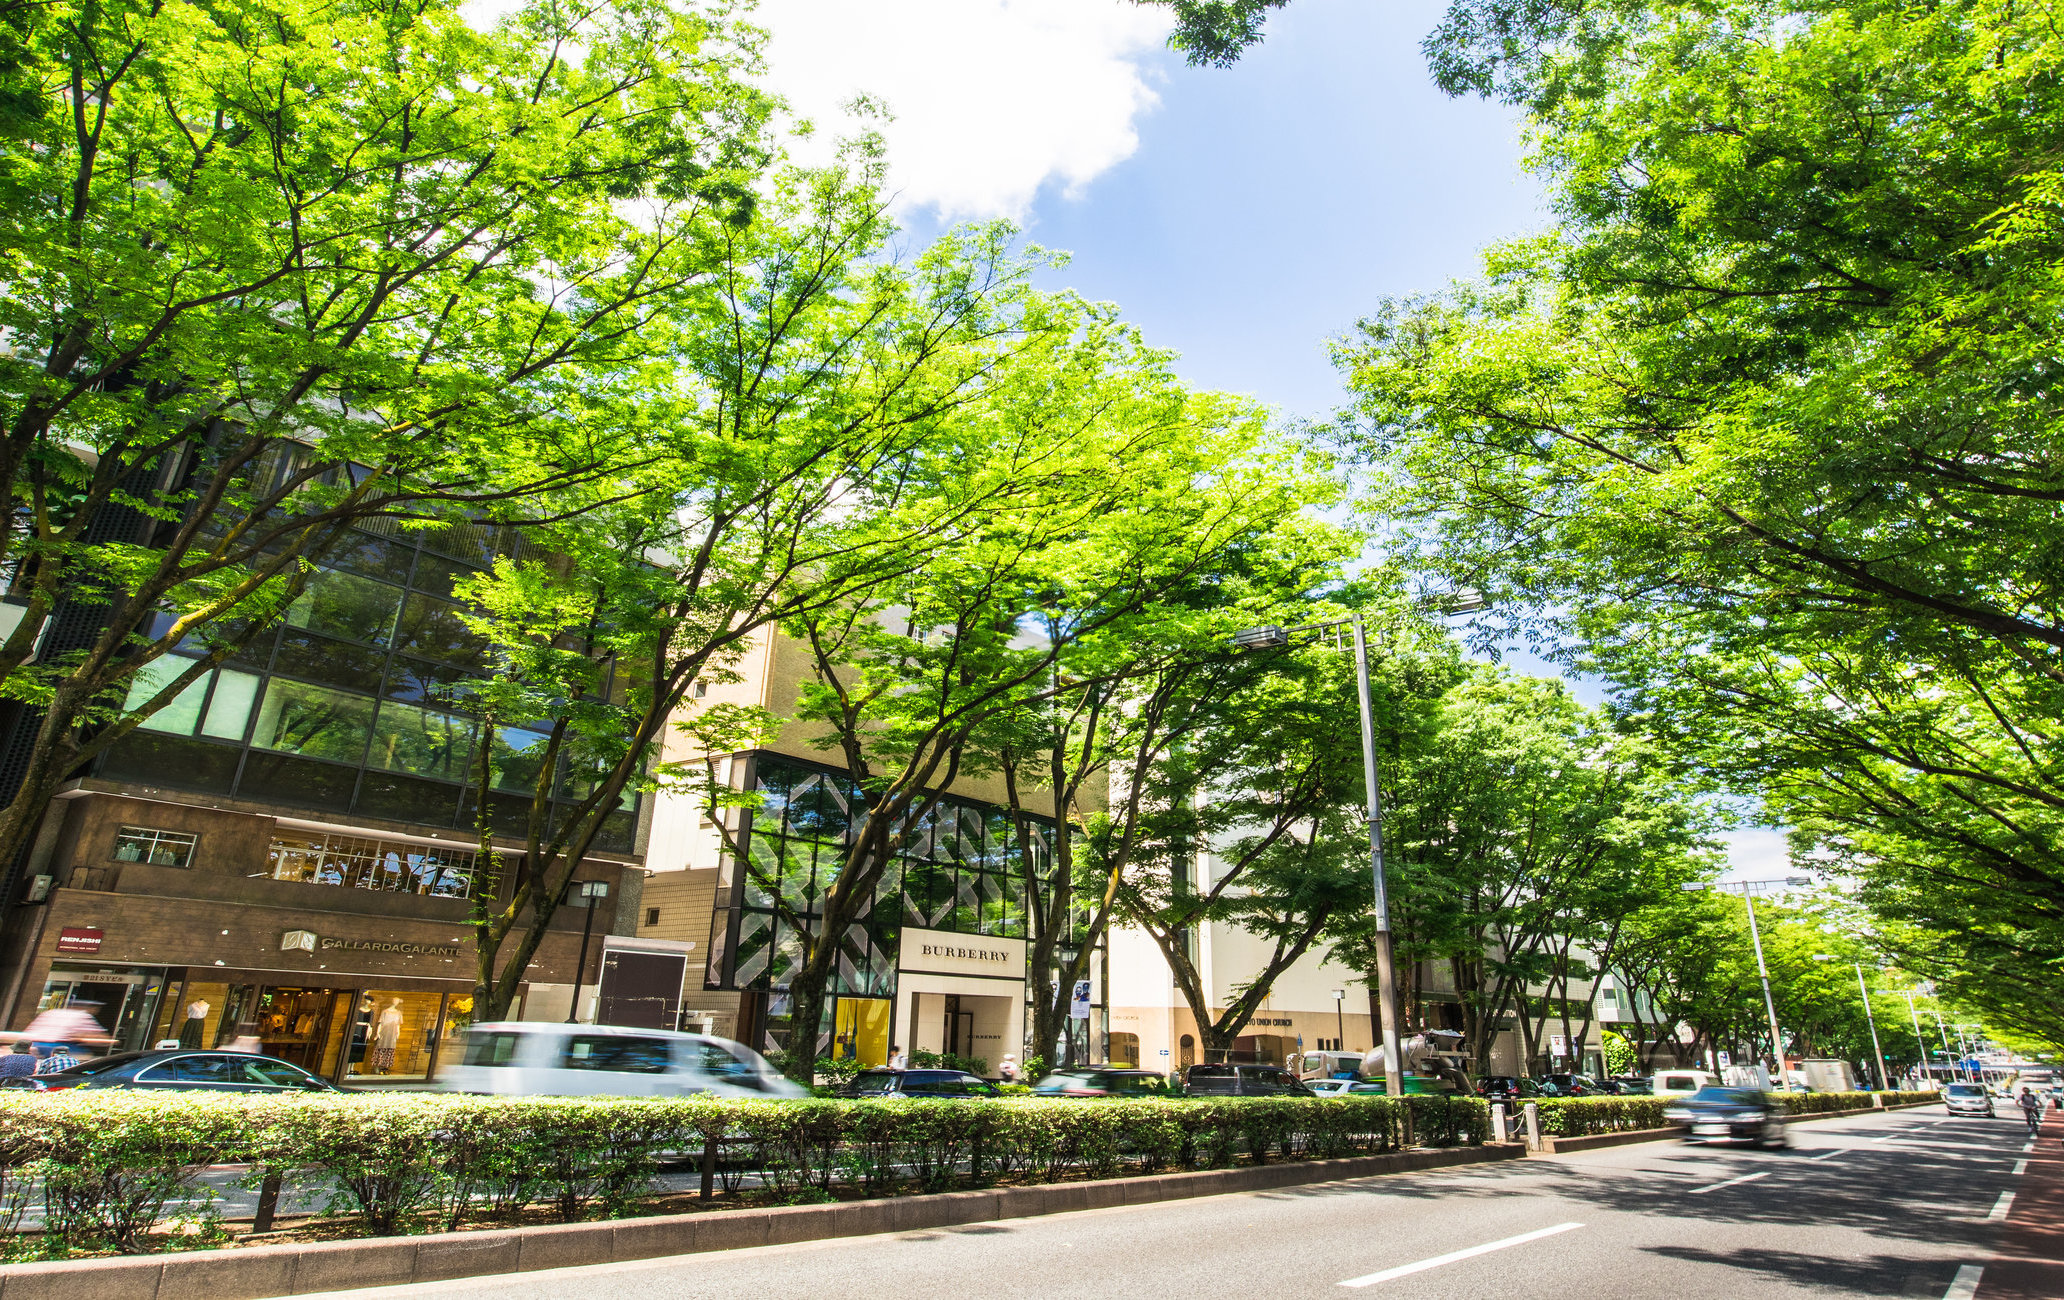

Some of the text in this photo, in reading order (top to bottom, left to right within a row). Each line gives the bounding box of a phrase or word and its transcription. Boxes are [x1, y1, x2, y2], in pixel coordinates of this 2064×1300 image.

[60, 936, 102, 944] RENJISHI
[921, 944, 1010, 961] BURBERRY
[1256, 1018, 1271, 1026] UNION
